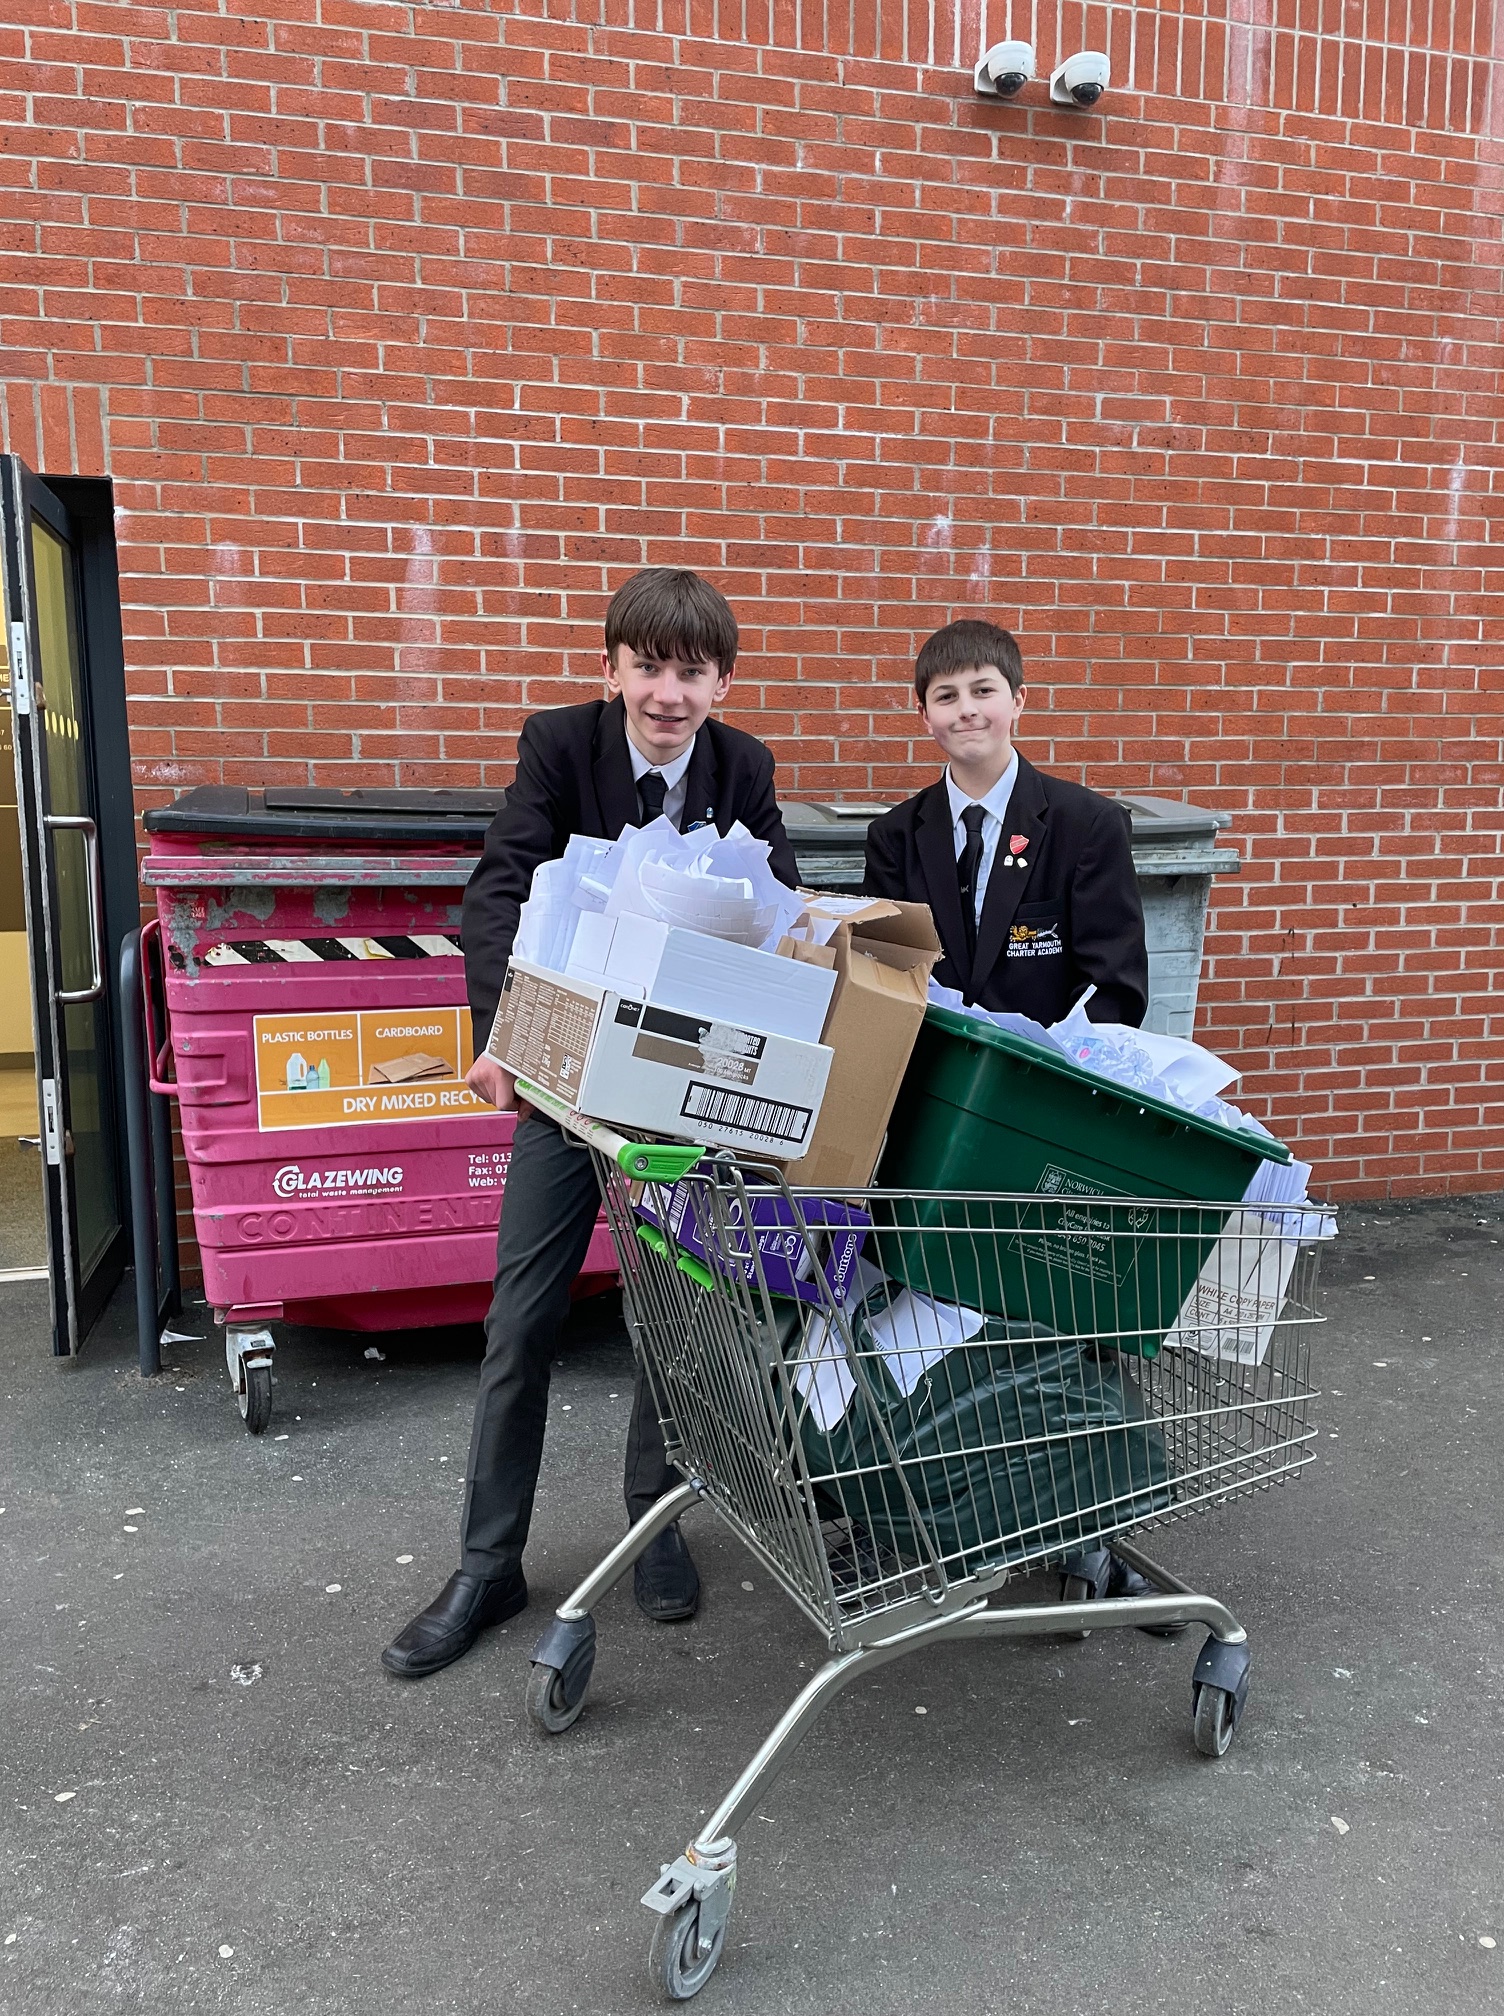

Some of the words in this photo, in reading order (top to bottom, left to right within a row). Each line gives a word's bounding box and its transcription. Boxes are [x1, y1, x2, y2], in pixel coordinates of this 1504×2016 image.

[1009, 942, 1029, 950] GREAT
[1032, 940, 1061, 949] YARMOUTH
[1006, 949, 1036, 957] CHARTER
[1037, 947, 1063, 956] ACADEMY
[262, 1031, 305, 1043] PLASTIC
[307, 1030, 353, 1041] BOTTLES
[376, 1026, 443, 1038] CARDBOARD
[717, 1057, 745, 1072] 20028
[343, 1096, 377, 1113] DRY
[381, 1092, 437, 1111] MIXED
[698, 1121, 713, 1130] 050
[719, 1126, 743, 1137] 27615
[749, 1132, 774, 1143] 20028
[468, 1153, 489, 1164] Tel:
[468, 1166, 492, 1176] Fax:
[281, 1166, 403, 1191] GLAZEWING
[468, 1176, 498, 1187] Web:
[299, 1190, 319, 1198] total
[321, 1189, 347, 1197] waste
[350, 1186, 403, 1195] management
